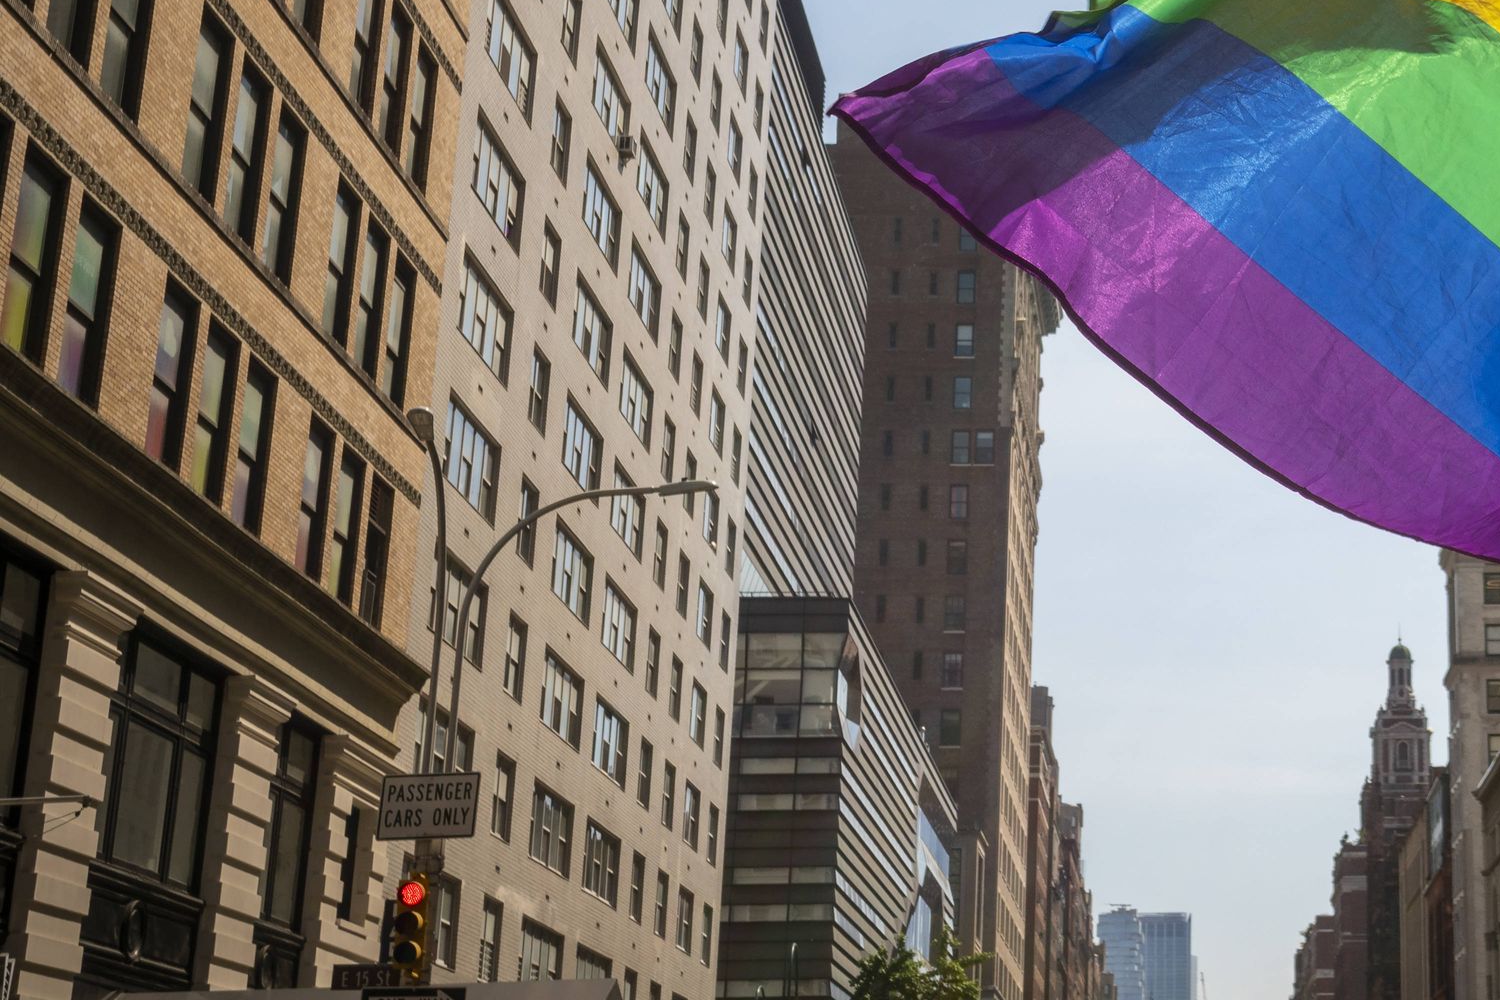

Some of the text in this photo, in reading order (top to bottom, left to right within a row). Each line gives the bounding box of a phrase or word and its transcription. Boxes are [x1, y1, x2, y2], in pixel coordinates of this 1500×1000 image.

[388, 782, 473, 803] PASSENGER
[385, 807, 470, 828] CARS ONLY
[342, 970, 390, 988] E 15 St
